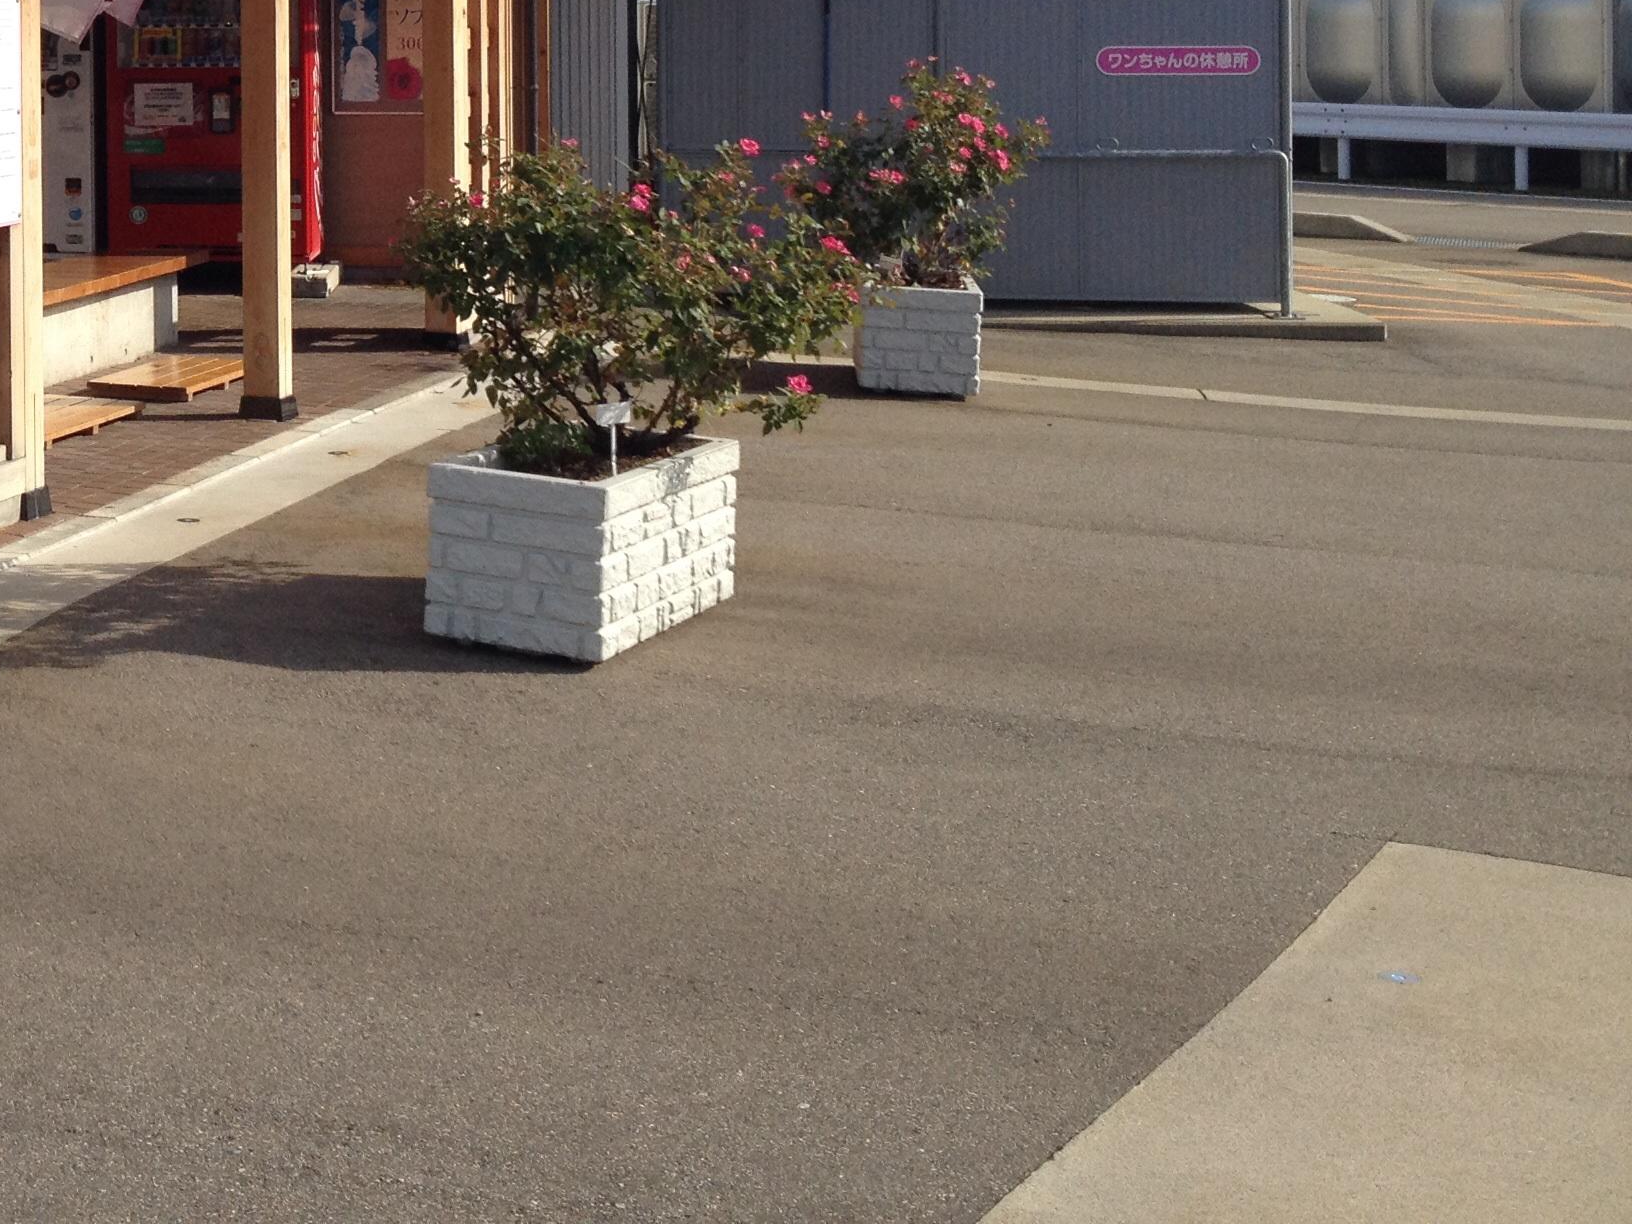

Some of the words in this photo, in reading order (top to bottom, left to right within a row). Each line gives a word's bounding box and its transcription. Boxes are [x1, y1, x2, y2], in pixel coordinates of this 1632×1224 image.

[1108, 51, 1249, 70] ワンちゃんの休憩所
